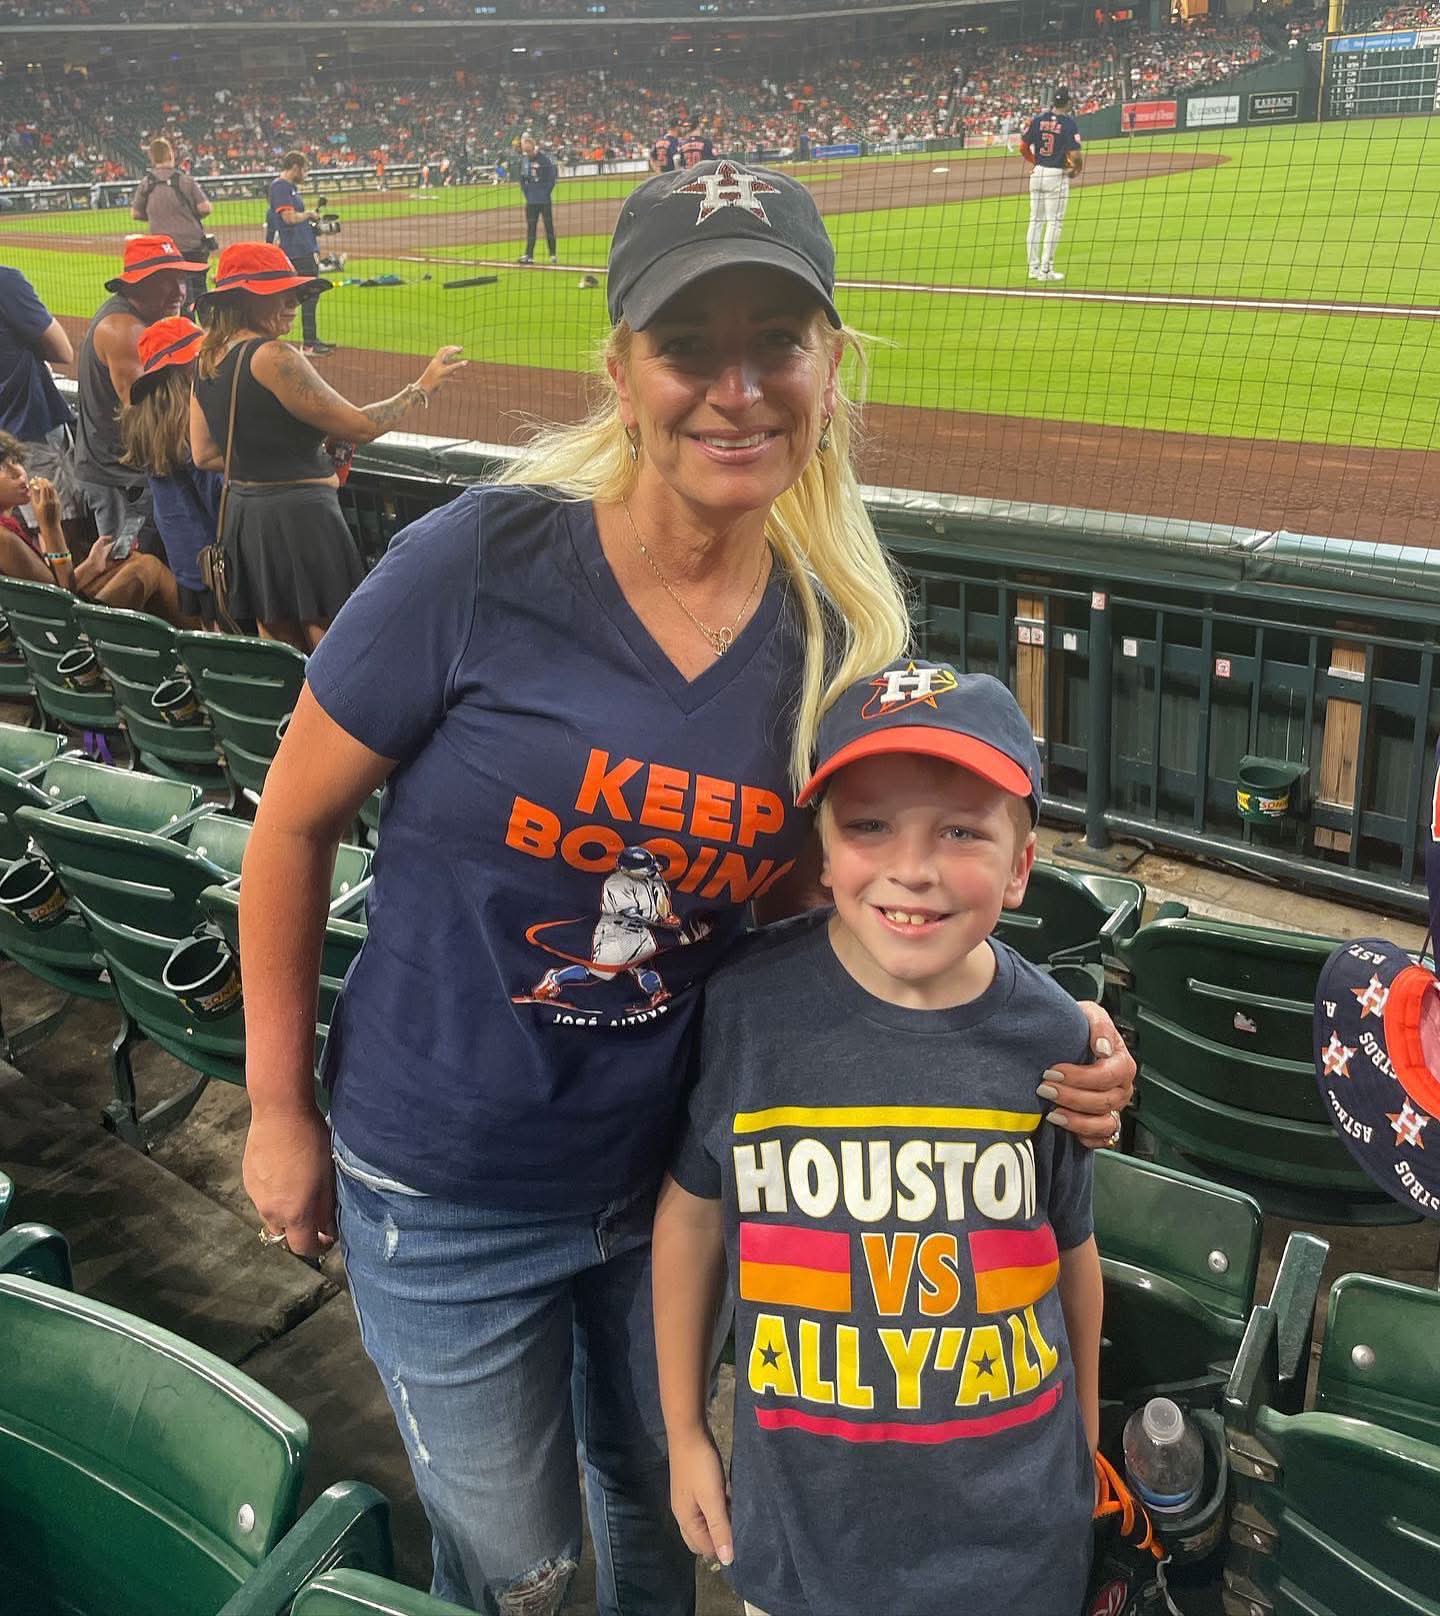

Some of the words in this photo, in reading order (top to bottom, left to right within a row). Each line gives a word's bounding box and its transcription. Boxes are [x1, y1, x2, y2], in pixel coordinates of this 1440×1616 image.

[1040, 133, 1055, 156] 3
[698, 175, 759, 208] H
[881, 669, 942, 703] H
[574, 747, 785, 848] KEEP
[505, 795, 796, 904] BOOIN
[733, 1127, 1036, 1222] HOUSTON
[861, 1232, 961, 1317] VS
[747, 1314, 874, 1409] ALL
[877, 1304, 1059, 1409] Y'ALL
